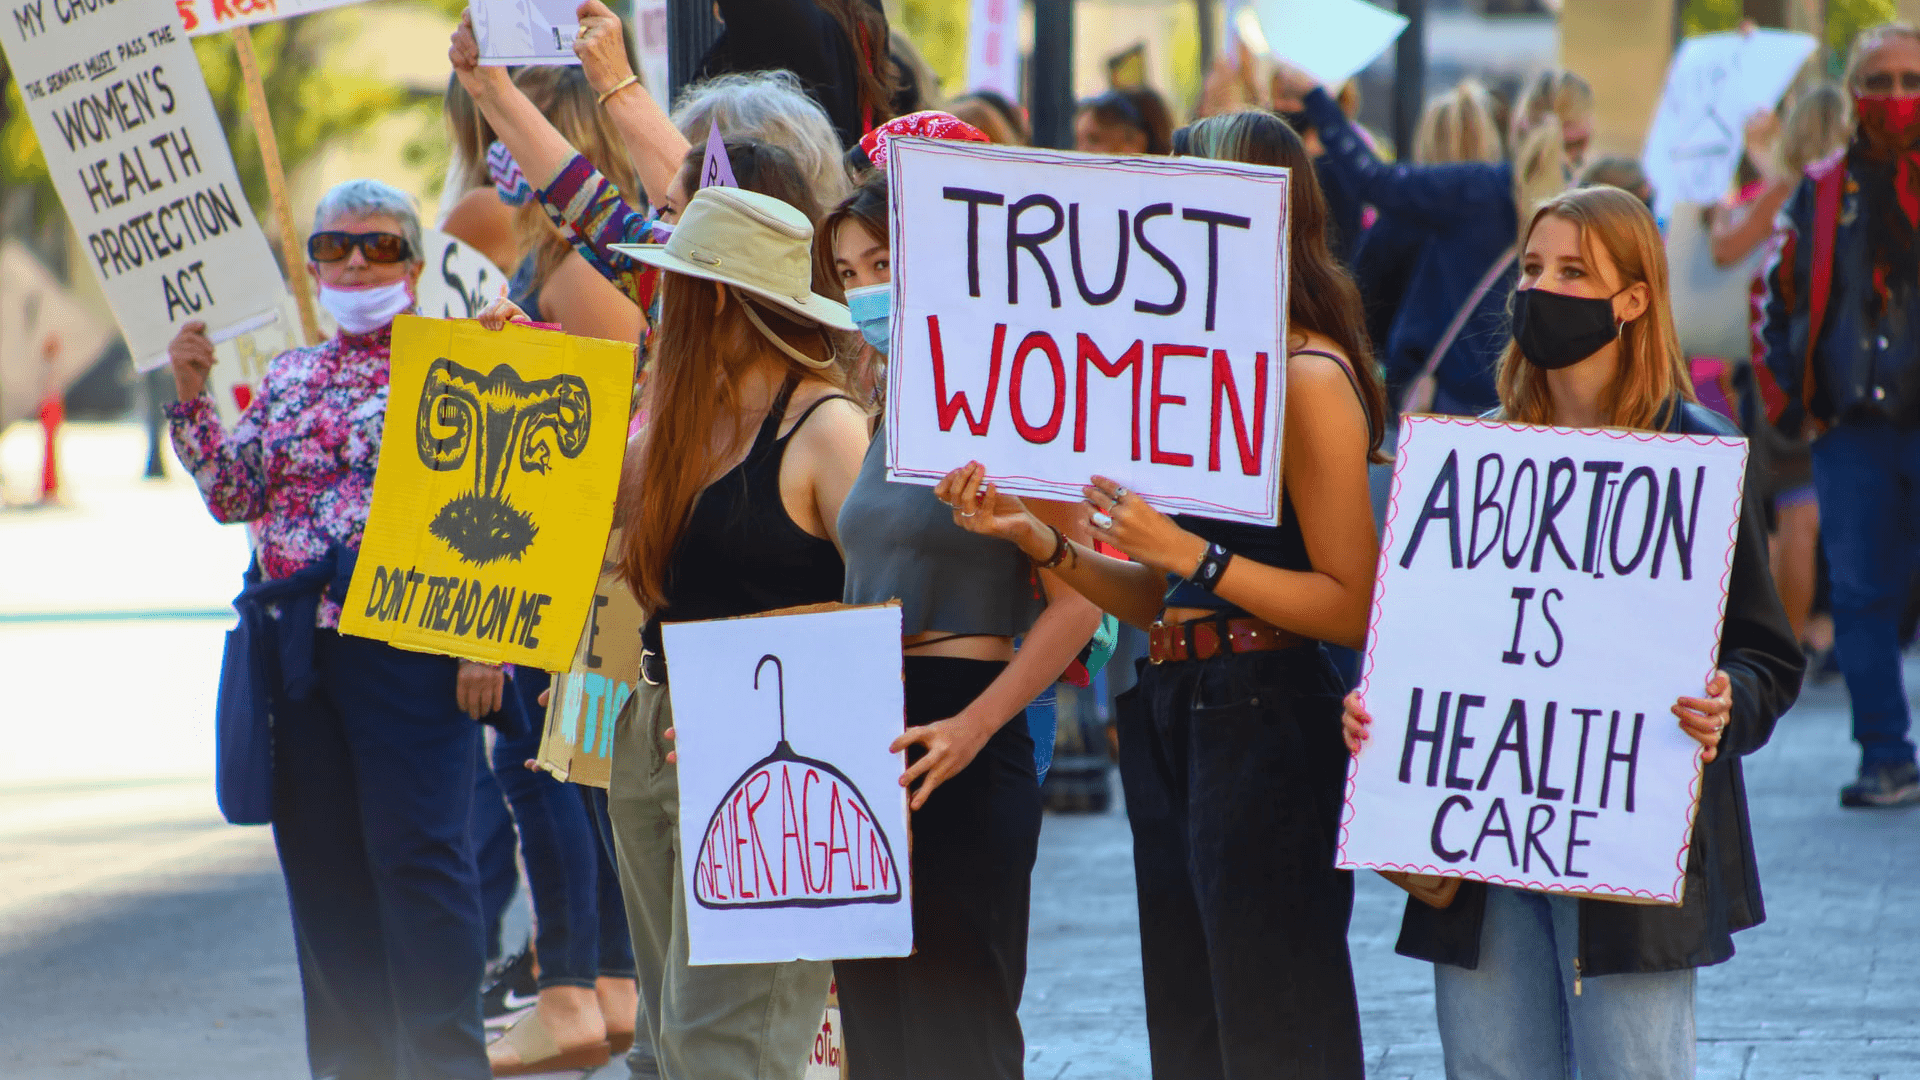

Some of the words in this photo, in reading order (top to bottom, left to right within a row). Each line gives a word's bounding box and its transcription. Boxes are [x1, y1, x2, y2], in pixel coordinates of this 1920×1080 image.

[13, 0, 45, 42] MY
[25, 80, 45, 101] THE
[46, 63, 85, 94] SENATE
[84, 49, 116, 80] MUST
[117, 36, 147, 61] PASS
[147, 25, 176, 48] THE
[52, 65, 176, 152] WOMEN'S
[79, 126, 202, 213] HEALTH
[88, 183, 242, 279] PROTECTION
[942, 186, 1251, 331] TRUST
[162, 261, 214, 321] ACT
[927, 315, 1268, 476] WOMEN
[1399, 448, 1706, 580] ABORTION
[418, 576, 482, 637] TREAD
[476, 584, 516, 643] ON
[508, 590, 552, 650] ME
[1502, 587, 1564, 668] IS
[1398, 687, 1645, 812] HEALTH
[700, 770, 778, 900] NEVER
[782, 764, 889, 896] AGAIN
[1430, 795, 1598, 878] CARE
